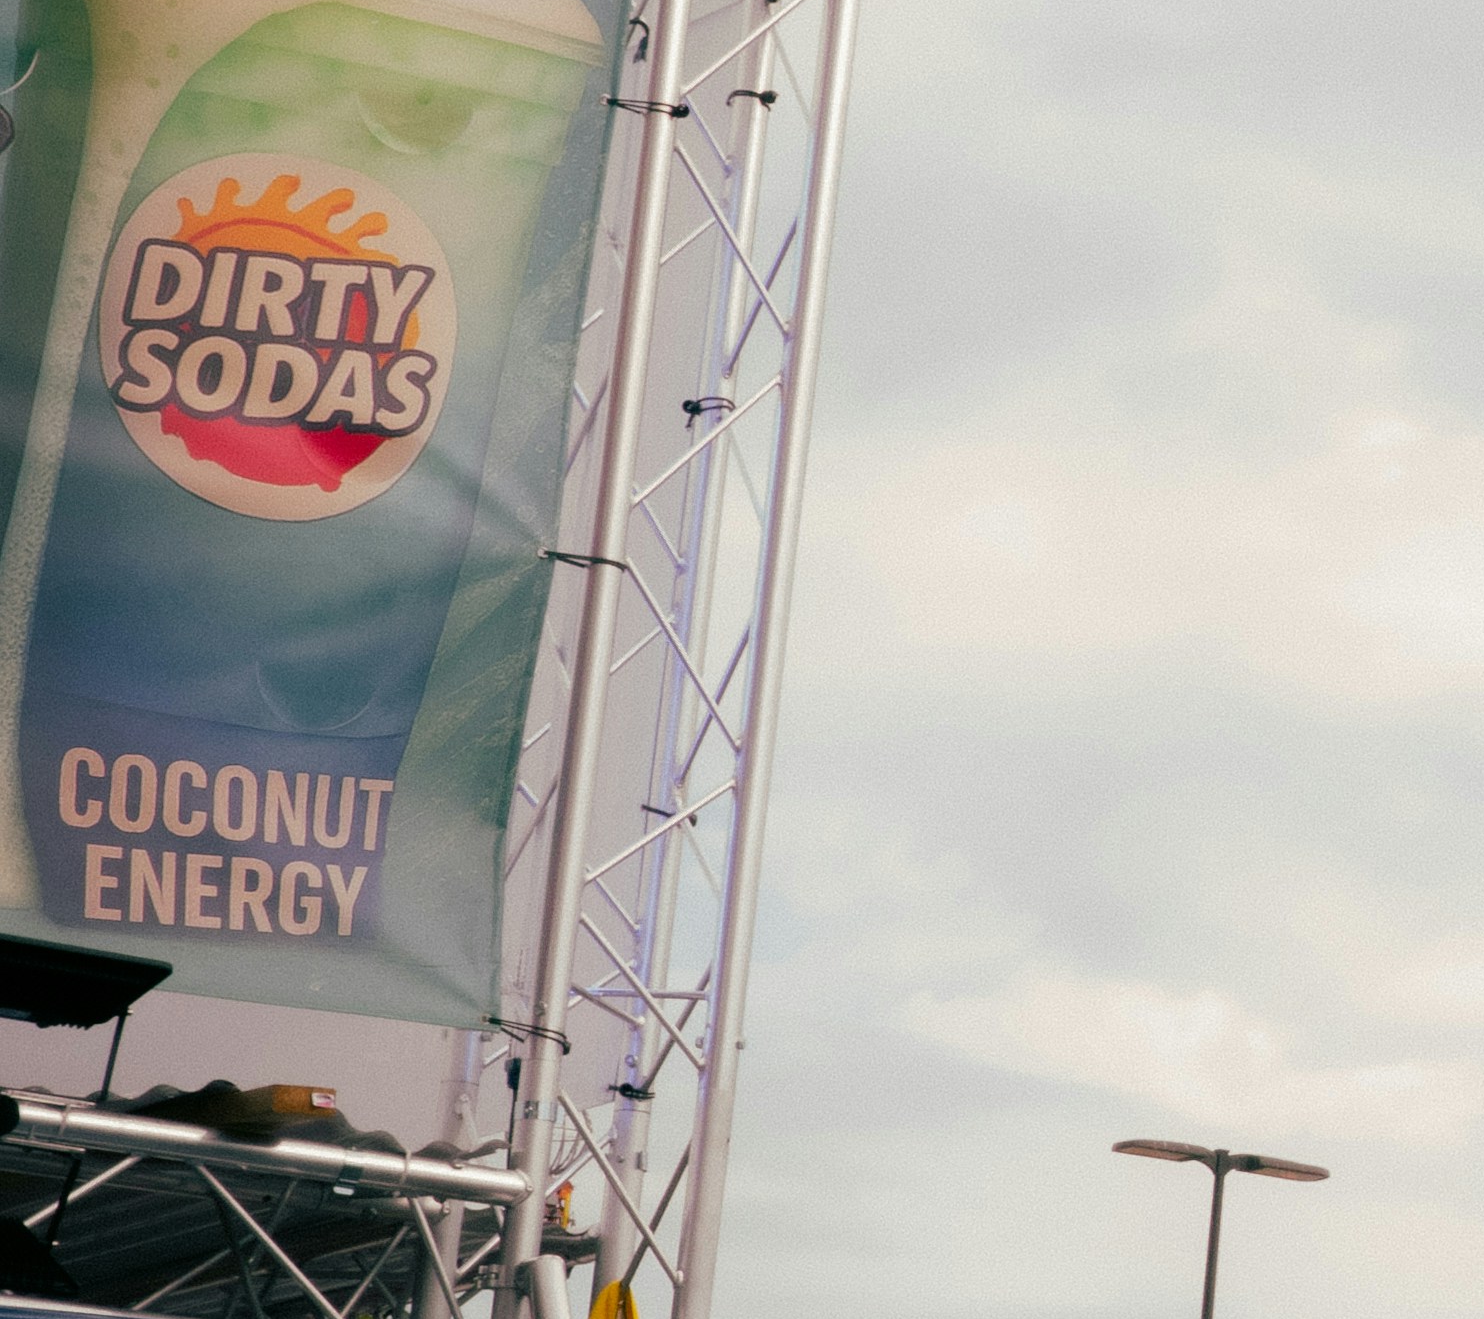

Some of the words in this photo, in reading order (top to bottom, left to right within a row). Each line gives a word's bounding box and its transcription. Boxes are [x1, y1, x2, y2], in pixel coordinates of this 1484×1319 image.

[124, 240, 434, 347] DIRTY
[112, 326, 435, 435] SODAS
[58, 747, 394, 851] COCONUT
[84, 844, 369, 936] ENERGY
